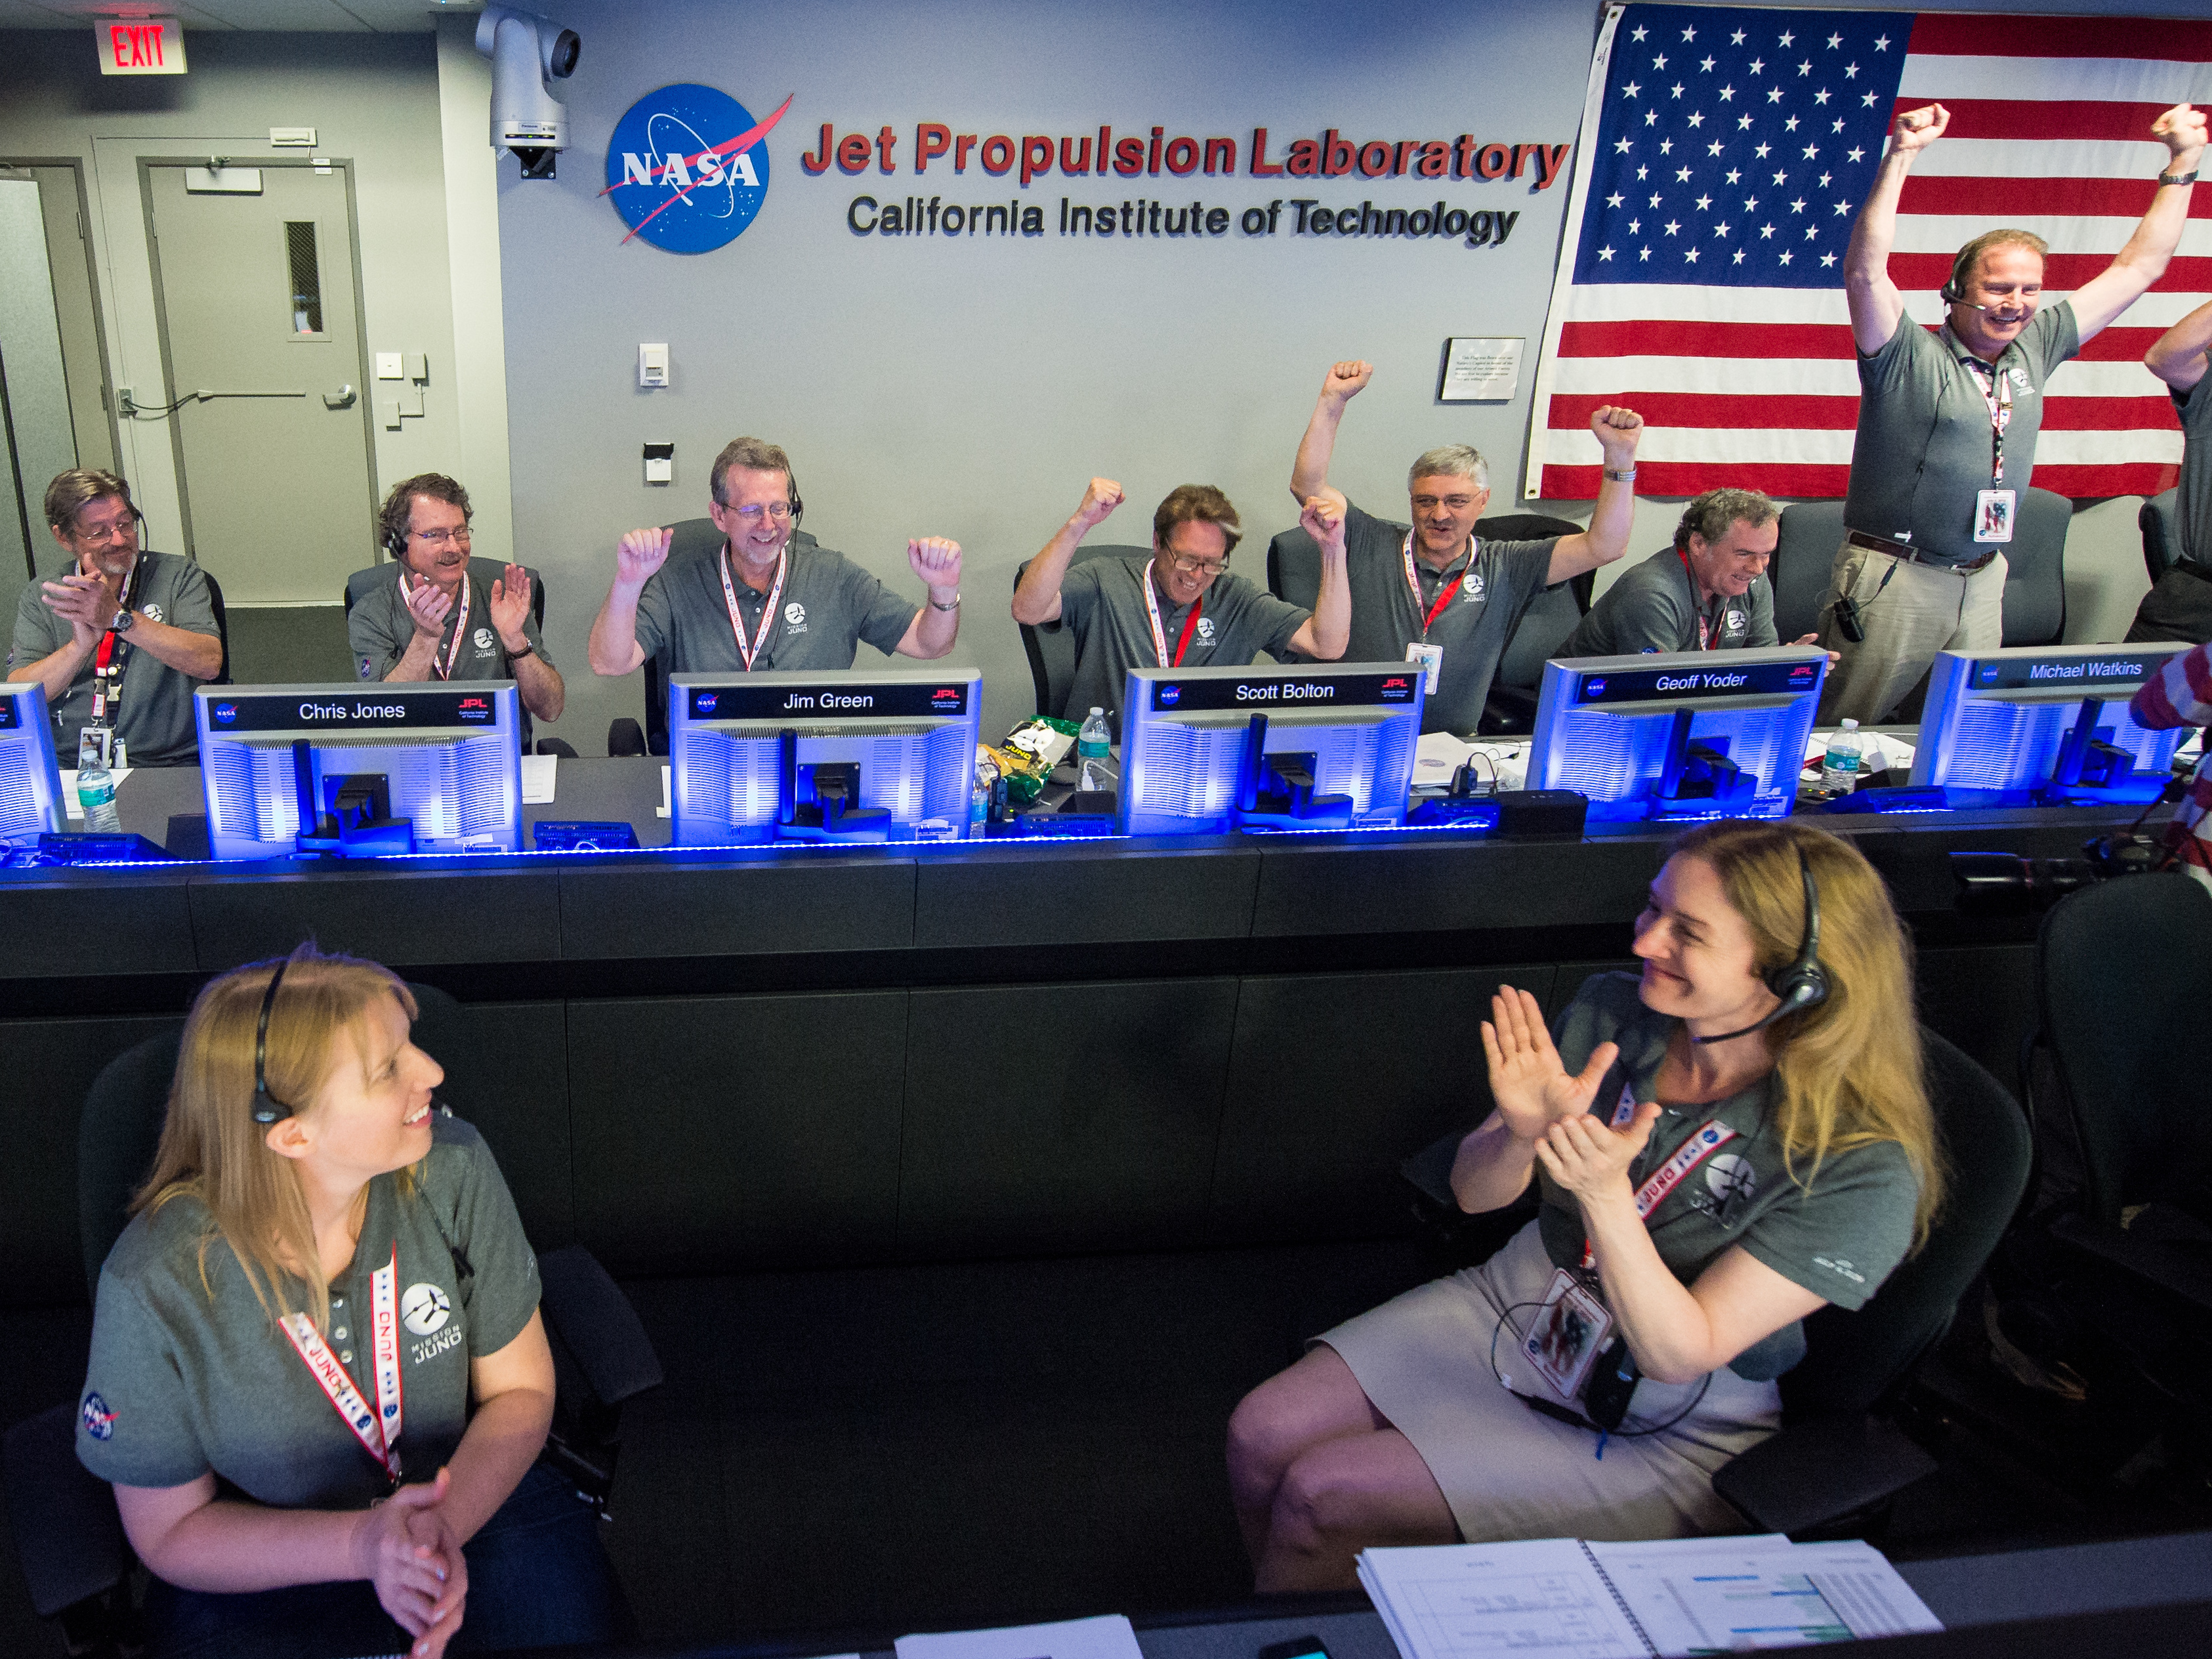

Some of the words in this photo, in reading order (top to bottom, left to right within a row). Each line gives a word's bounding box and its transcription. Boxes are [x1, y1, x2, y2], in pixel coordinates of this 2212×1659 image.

[110, 24, 164, 68] EXIT
[802, 123, 897, 172] Jet
[915, 123, 1238, 184] Propulsion
[1250, 127, 1572, 190] Laboratory
[621, 152, 760, 187] NASA
[848, 196, 1045, 234] California
[1060, 197, 1230, 235] Institute
[1242, 199, 1283, 235] of
[1291, 199, 1521, 245] Technology
[732, 608, 741, 628] JUNO
[764, 608, 773, 629] JUNO
[1789, 667, 1813, 676] JPL
[2030, 663, 2086, 679] Michael
[2087, 662, 2143, 677] Watkins
[1382, 679, 1408, 688] JPL
[1656, 675, 1700, 690] Geoff
[1703, 673, 1748, 688] Yoder
[783, 694, 814, 709] Jim
[820, 693, 874, 709] Green
[932, 690, 959, 699] JPL
[1236, 685, 1279, 700] Scott
[1282, 684, 1334, 699] Bolton
[299, 703, 347, 720] Chris
[351, 702, 406, 719] Jones
[459, 698, 488, 708] JPL
[1005, 744, 1033, 761] JUNO
[1644, 1167, 1676, 1204] JUNO
[379, 1311, 392, 1361] JUNO
[411, 1324, 460, 1354] MISSION
[415, 1331, 462, 1365] JUNO
[309, 1348, 342, 1388] JUNO
